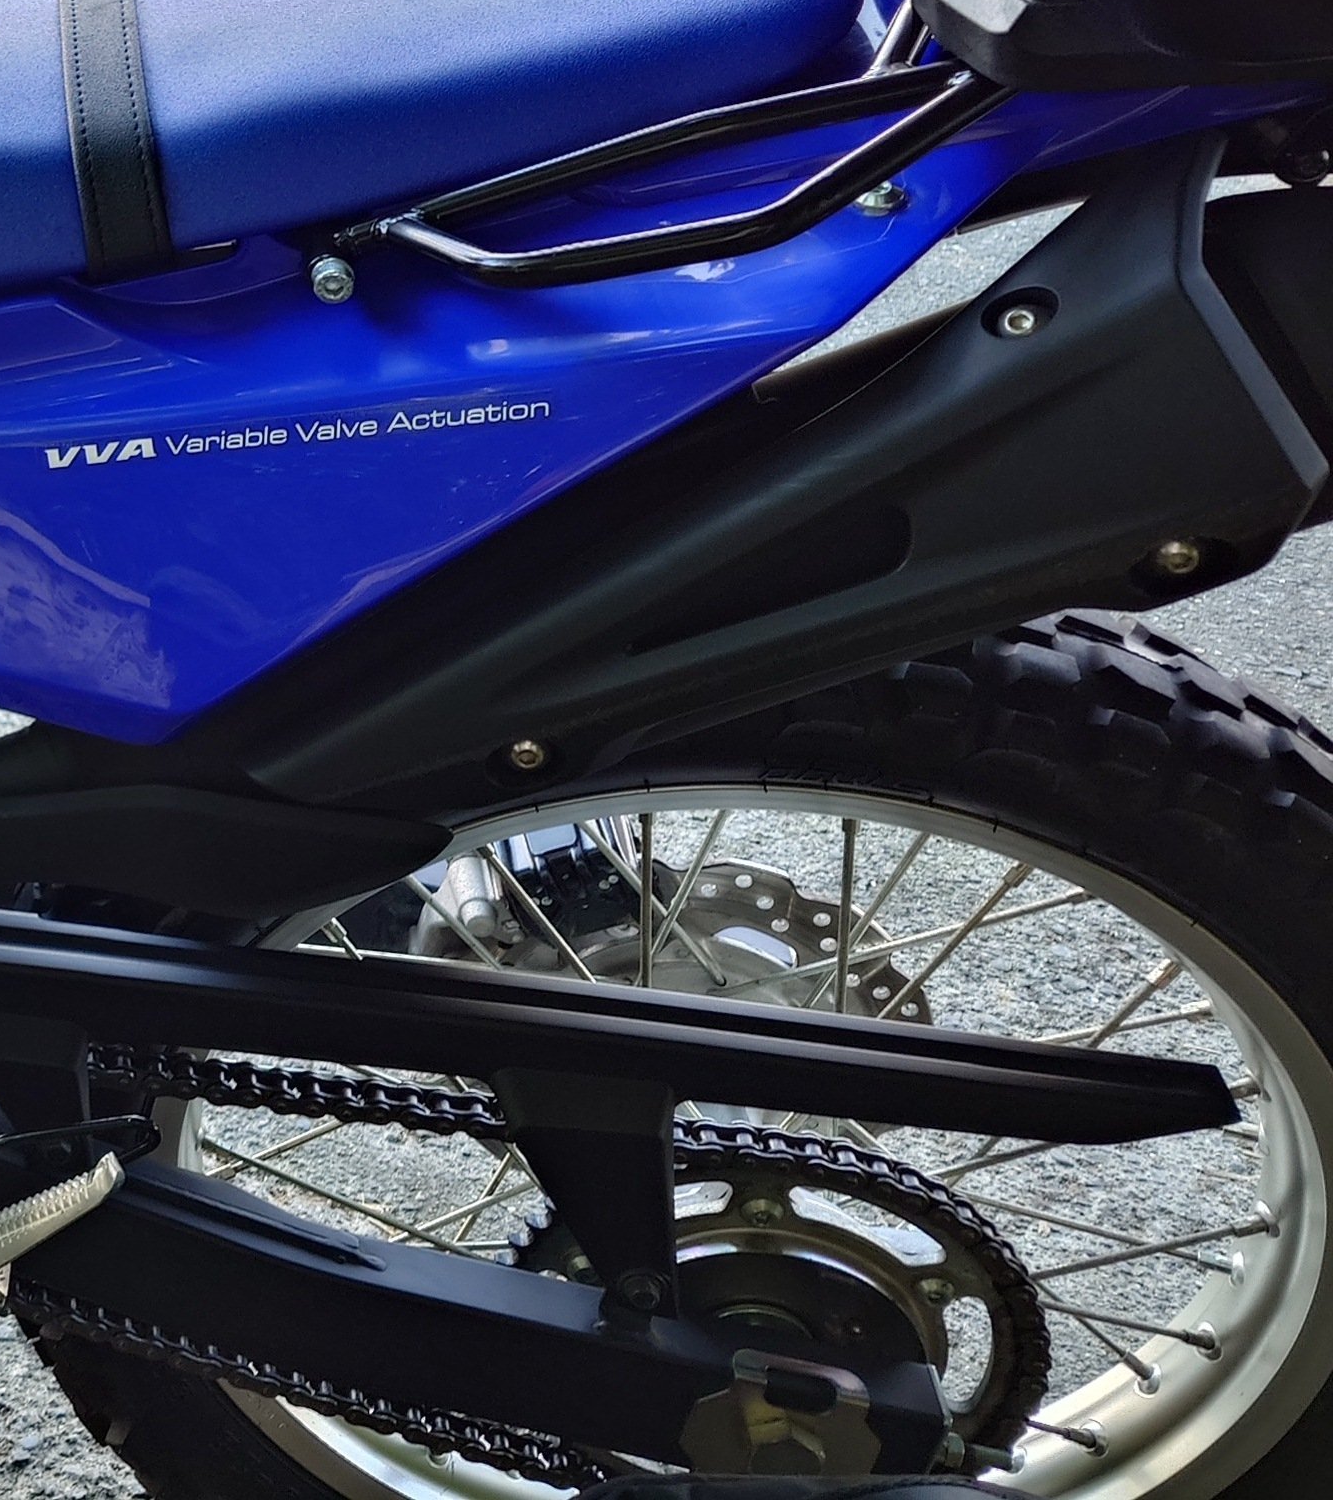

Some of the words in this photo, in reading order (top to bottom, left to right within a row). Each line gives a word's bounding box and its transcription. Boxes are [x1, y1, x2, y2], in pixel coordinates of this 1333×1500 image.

[44, 437, 157, 470] VVA
[165, 424, 289, 456] Variable
[295, 418, 379, 443] Valve
[386, 400, 551, 434] Actuation
